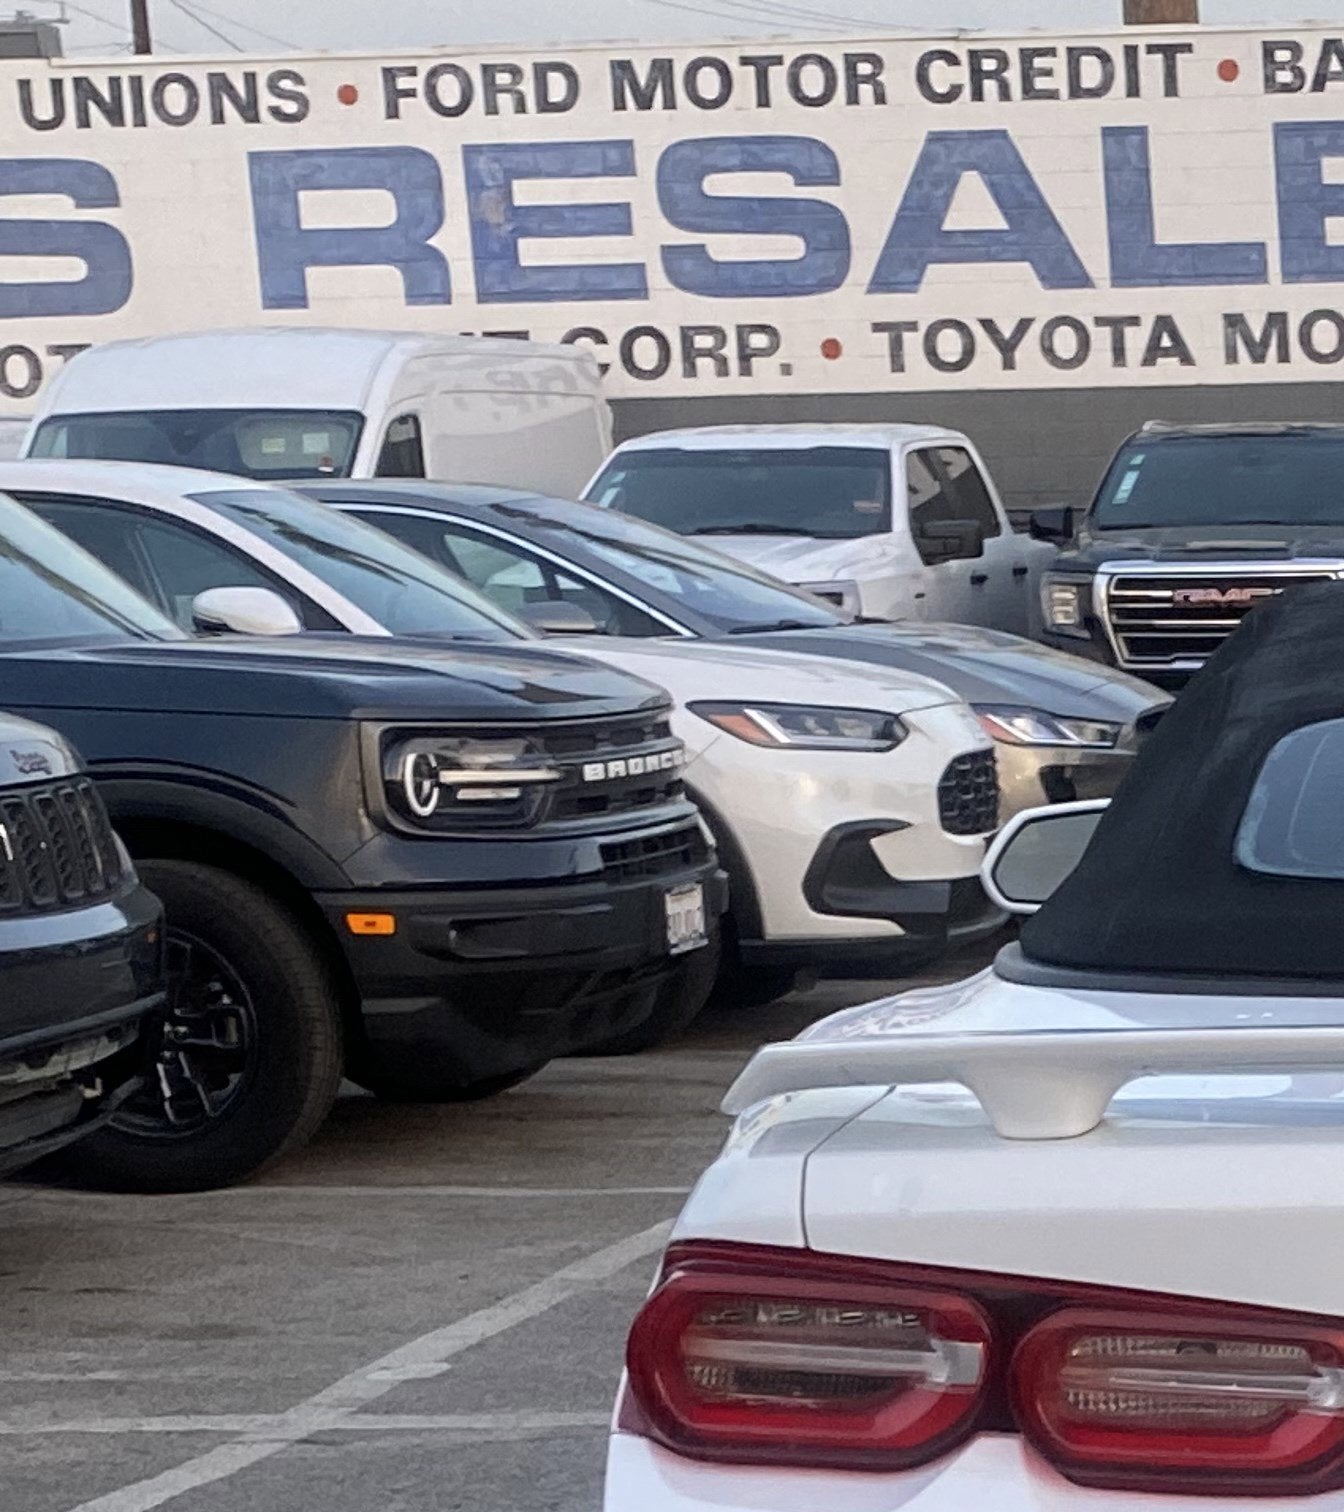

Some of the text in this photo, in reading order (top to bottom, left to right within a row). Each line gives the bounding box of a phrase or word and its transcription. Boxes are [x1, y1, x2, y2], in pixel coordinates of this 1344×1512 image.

[17, 68, 310, 132] UNIONS
[380, 60, 581, 120] FORD
[609, 50, 888, 112] MOTOR
[914, 41, 1194, 104] CREDIT
[872, 314, 1195, 374] TOYOTA
